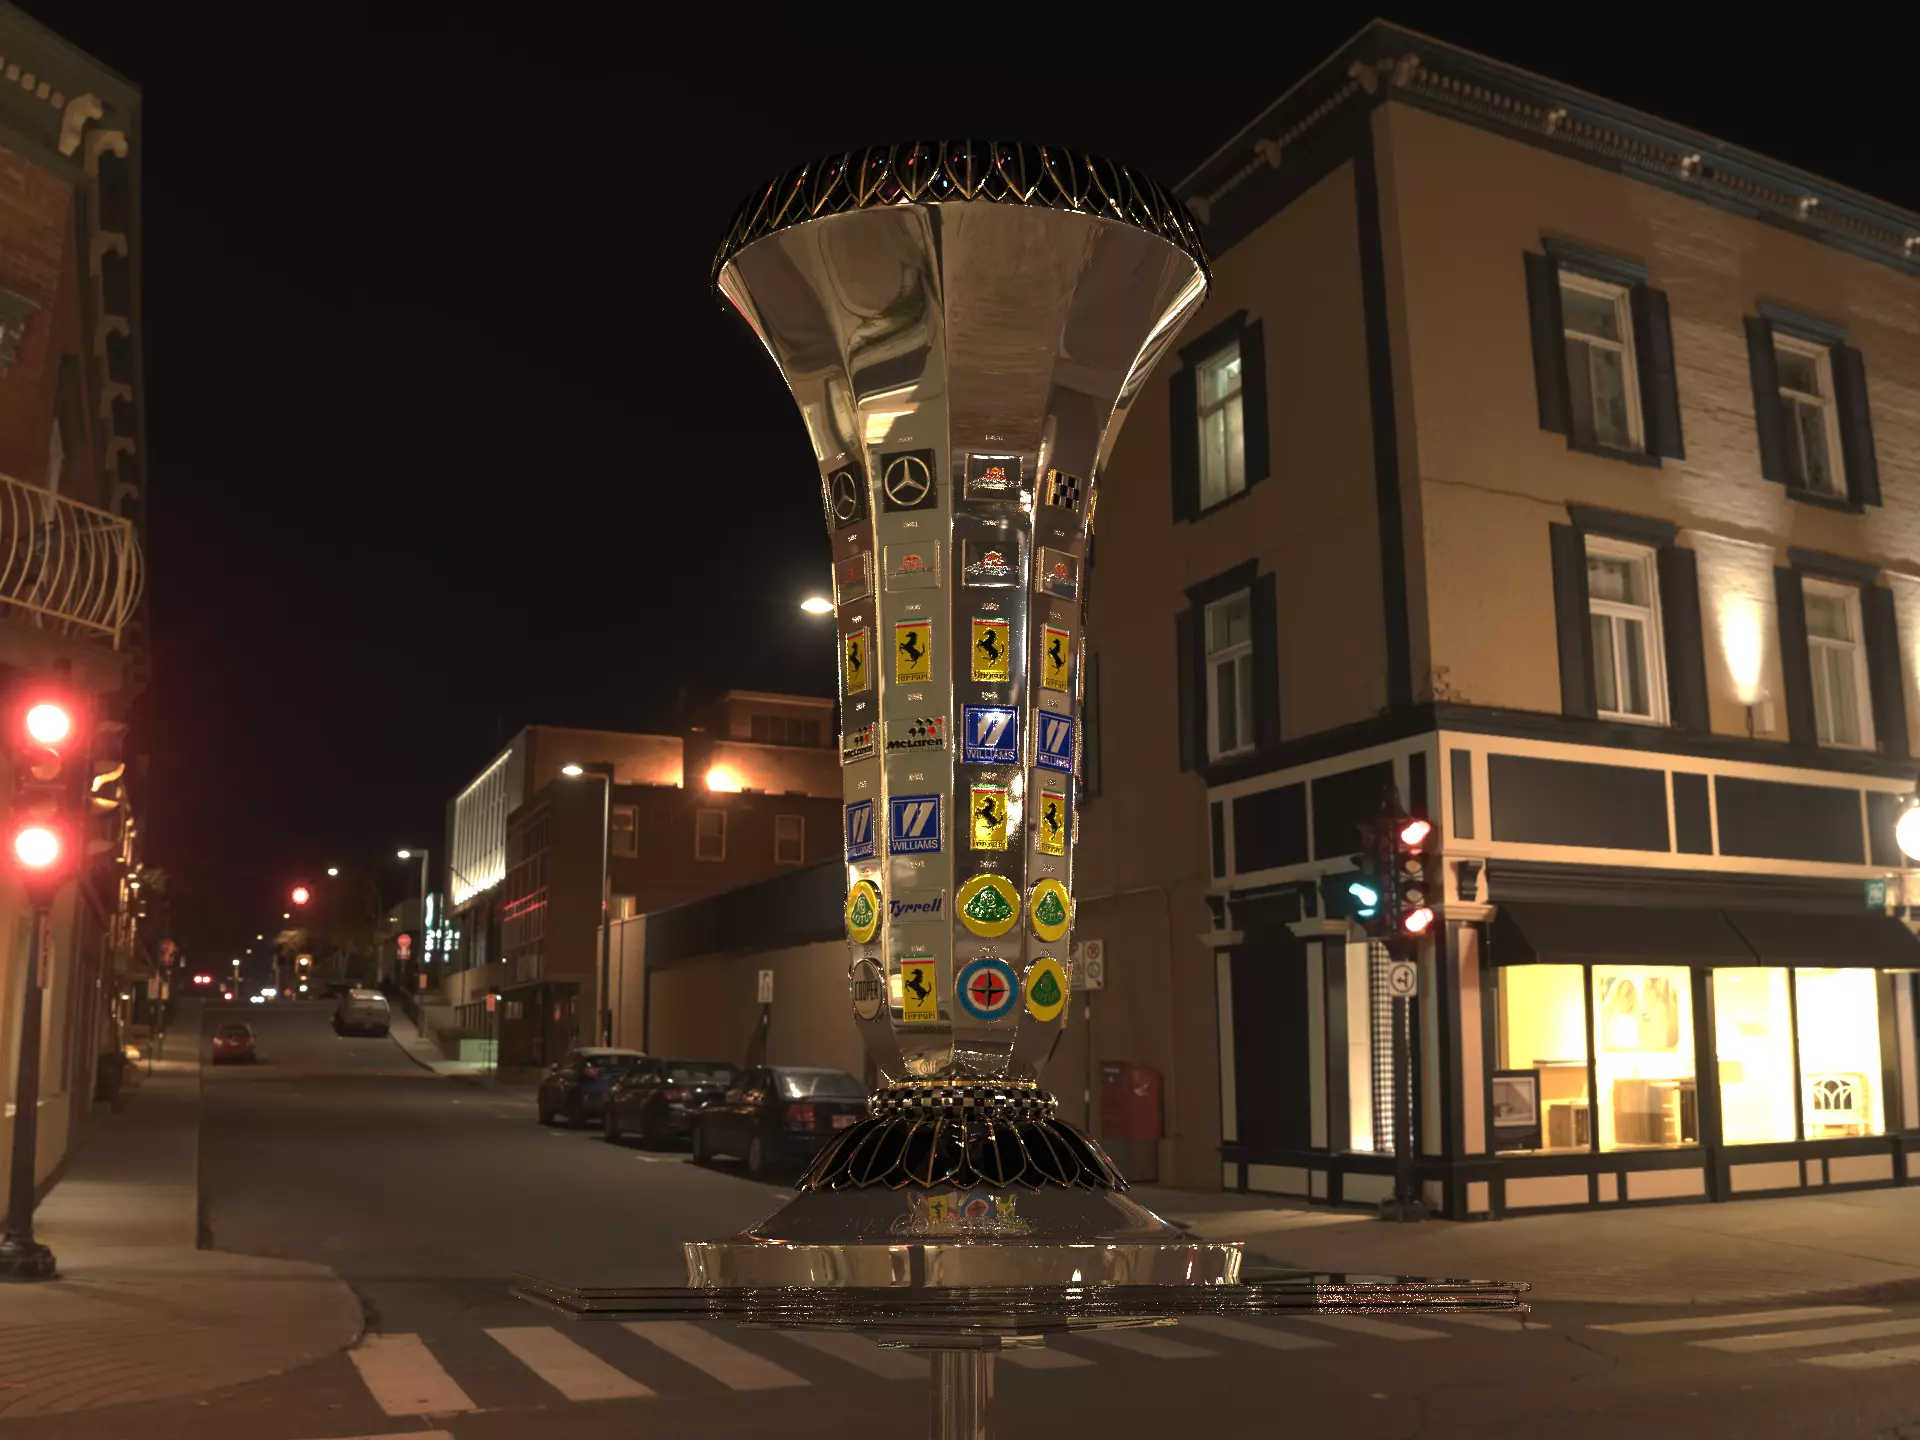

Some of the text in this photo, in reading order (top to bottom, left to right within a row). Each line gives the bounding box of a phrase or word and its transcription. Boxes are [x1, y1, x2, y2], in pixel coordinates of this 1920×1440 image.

[887, 738, 943, 749] McLaren
[966, 749, 1015, 760] WILLIAMS
[892, 839, 938, 851] WILLIAMS
[889, 897, 943, 917] Tyrrell
[851, 910, 873, 925] LOTUS
[854, 980, 879, 1001] COOPER
